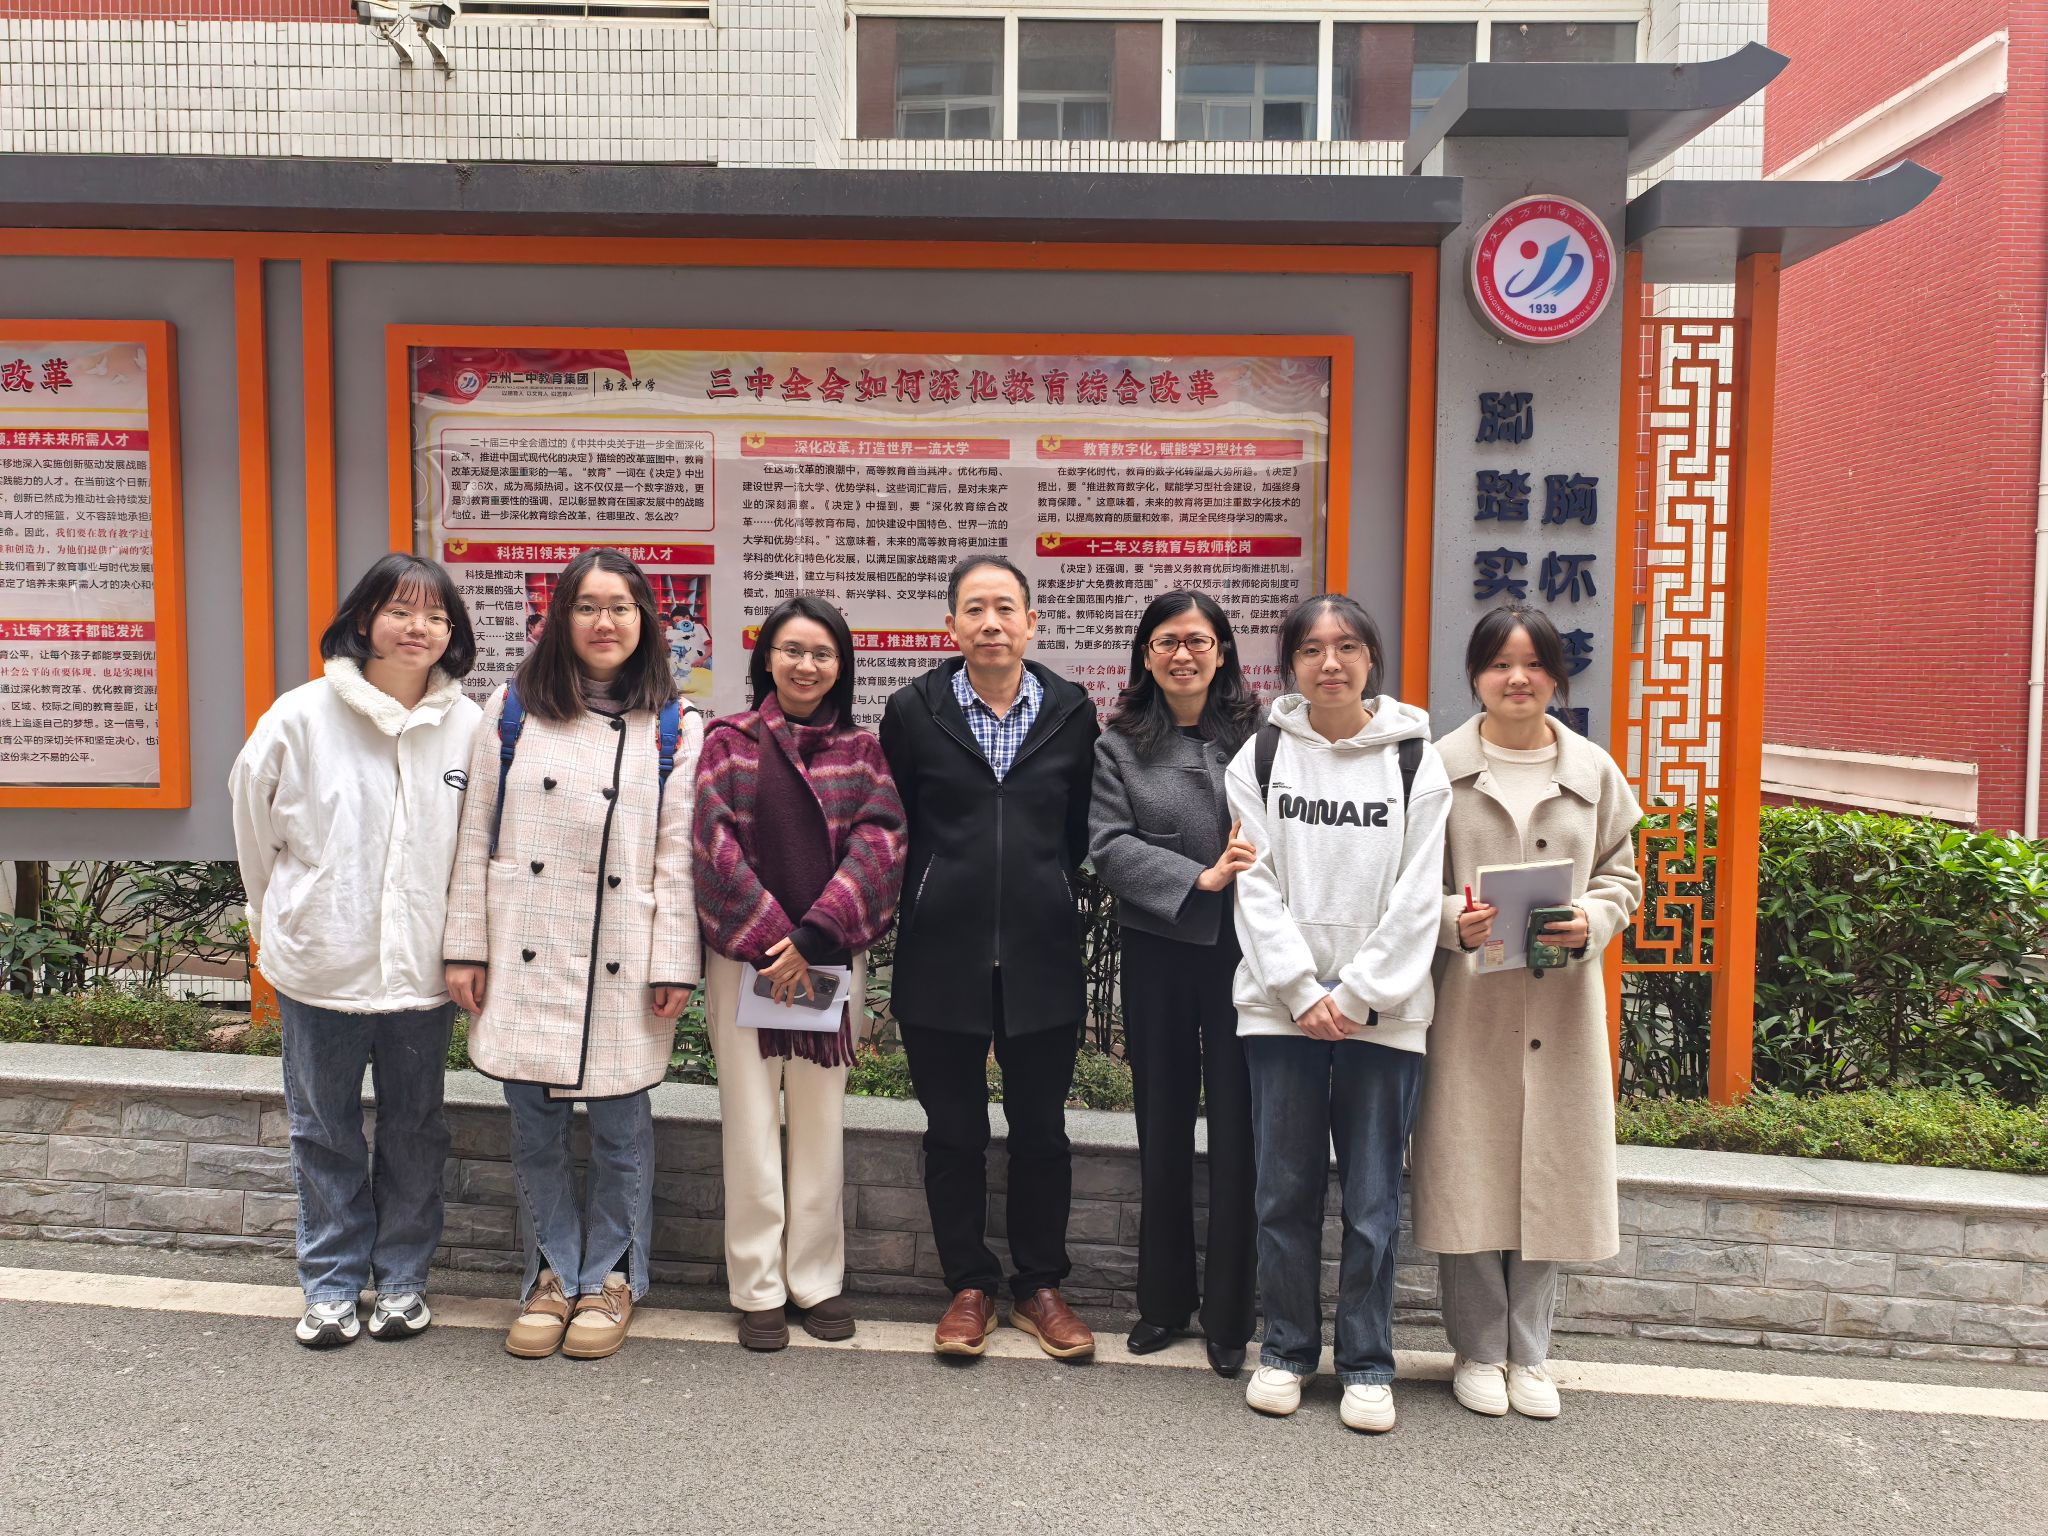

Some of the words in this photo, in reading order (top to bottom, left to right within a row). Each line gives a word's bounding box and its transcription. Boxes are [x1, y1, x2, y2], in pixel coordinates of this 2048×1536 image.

[1482, 276, 1505, 316] CHONGQING
[1504, 314, 1536, 332] WANZHOU
[1537, 321, 1568, 332] NANJING
[1569, 305, 1591, 325] MIDDLE
[1528, 303, 1557, 314] 1939
[1, 358, 73, 394] 改革
[487, 372, 589, 385] 万州二中教育集团
[603, 377, 656, 392] 南京中学
[706, 366, 1220, 404] 三中全会如何深化教育综合改革
[470, 437, 704, 450] 二十届三中全会通过的《中共中央关于进一步全面深化
[794, 439, 970, 456] 深化改革，打造世界一流大学
[1083, 442, 1256, 457] 教育数字化，赋能学习型社会
[0, 475, 151, 488] 践能力的人才。在当前这个日新
[0, 492, 151, 505] ，创新已然成为推动社会持续发
[0, 527, 152, 539] 命。因此，我们要在教育教学过
[0, 544, 152, 556] 和创造力，为他们提供广阔的实
[1086, 539, 1251, 554] 十二年义务教育与教师轮岗
[0, 561, 154, 573] 我们看到了教育事业与时代发展
[465, 569, 524, 580] 科技是推动未
[0, 578, 154, 590] 定了培养未来所需人才的决心和
[456, 584, 524, 595] 经济发展的强大
[475, 616, 520, 626] 人工智能、
[473, 631, 525, 641] 天……这些
[1037, 640, 1134, 650] 盖范围，为更多的孩子
[0, 649, 156, 661] 育公平，让每个孩子都能享受到优
[853, 676, 915, 687] 教育服务供
[0, 684, 157, 696] 通过深化教育改革、优化教育资源
[2, 701, 157, 712] 、区域、校际之间的教育差距，让
[0, 718, 158, 729] 线上追逐自己的梦想。这一信号，
[0, 735, 158, 747] 育公平的深切关怀和坚定决心，也
[1, 752, 95, 763] 这份来之不易的公平。
[1279, 793, 1388, 827] MINAR
